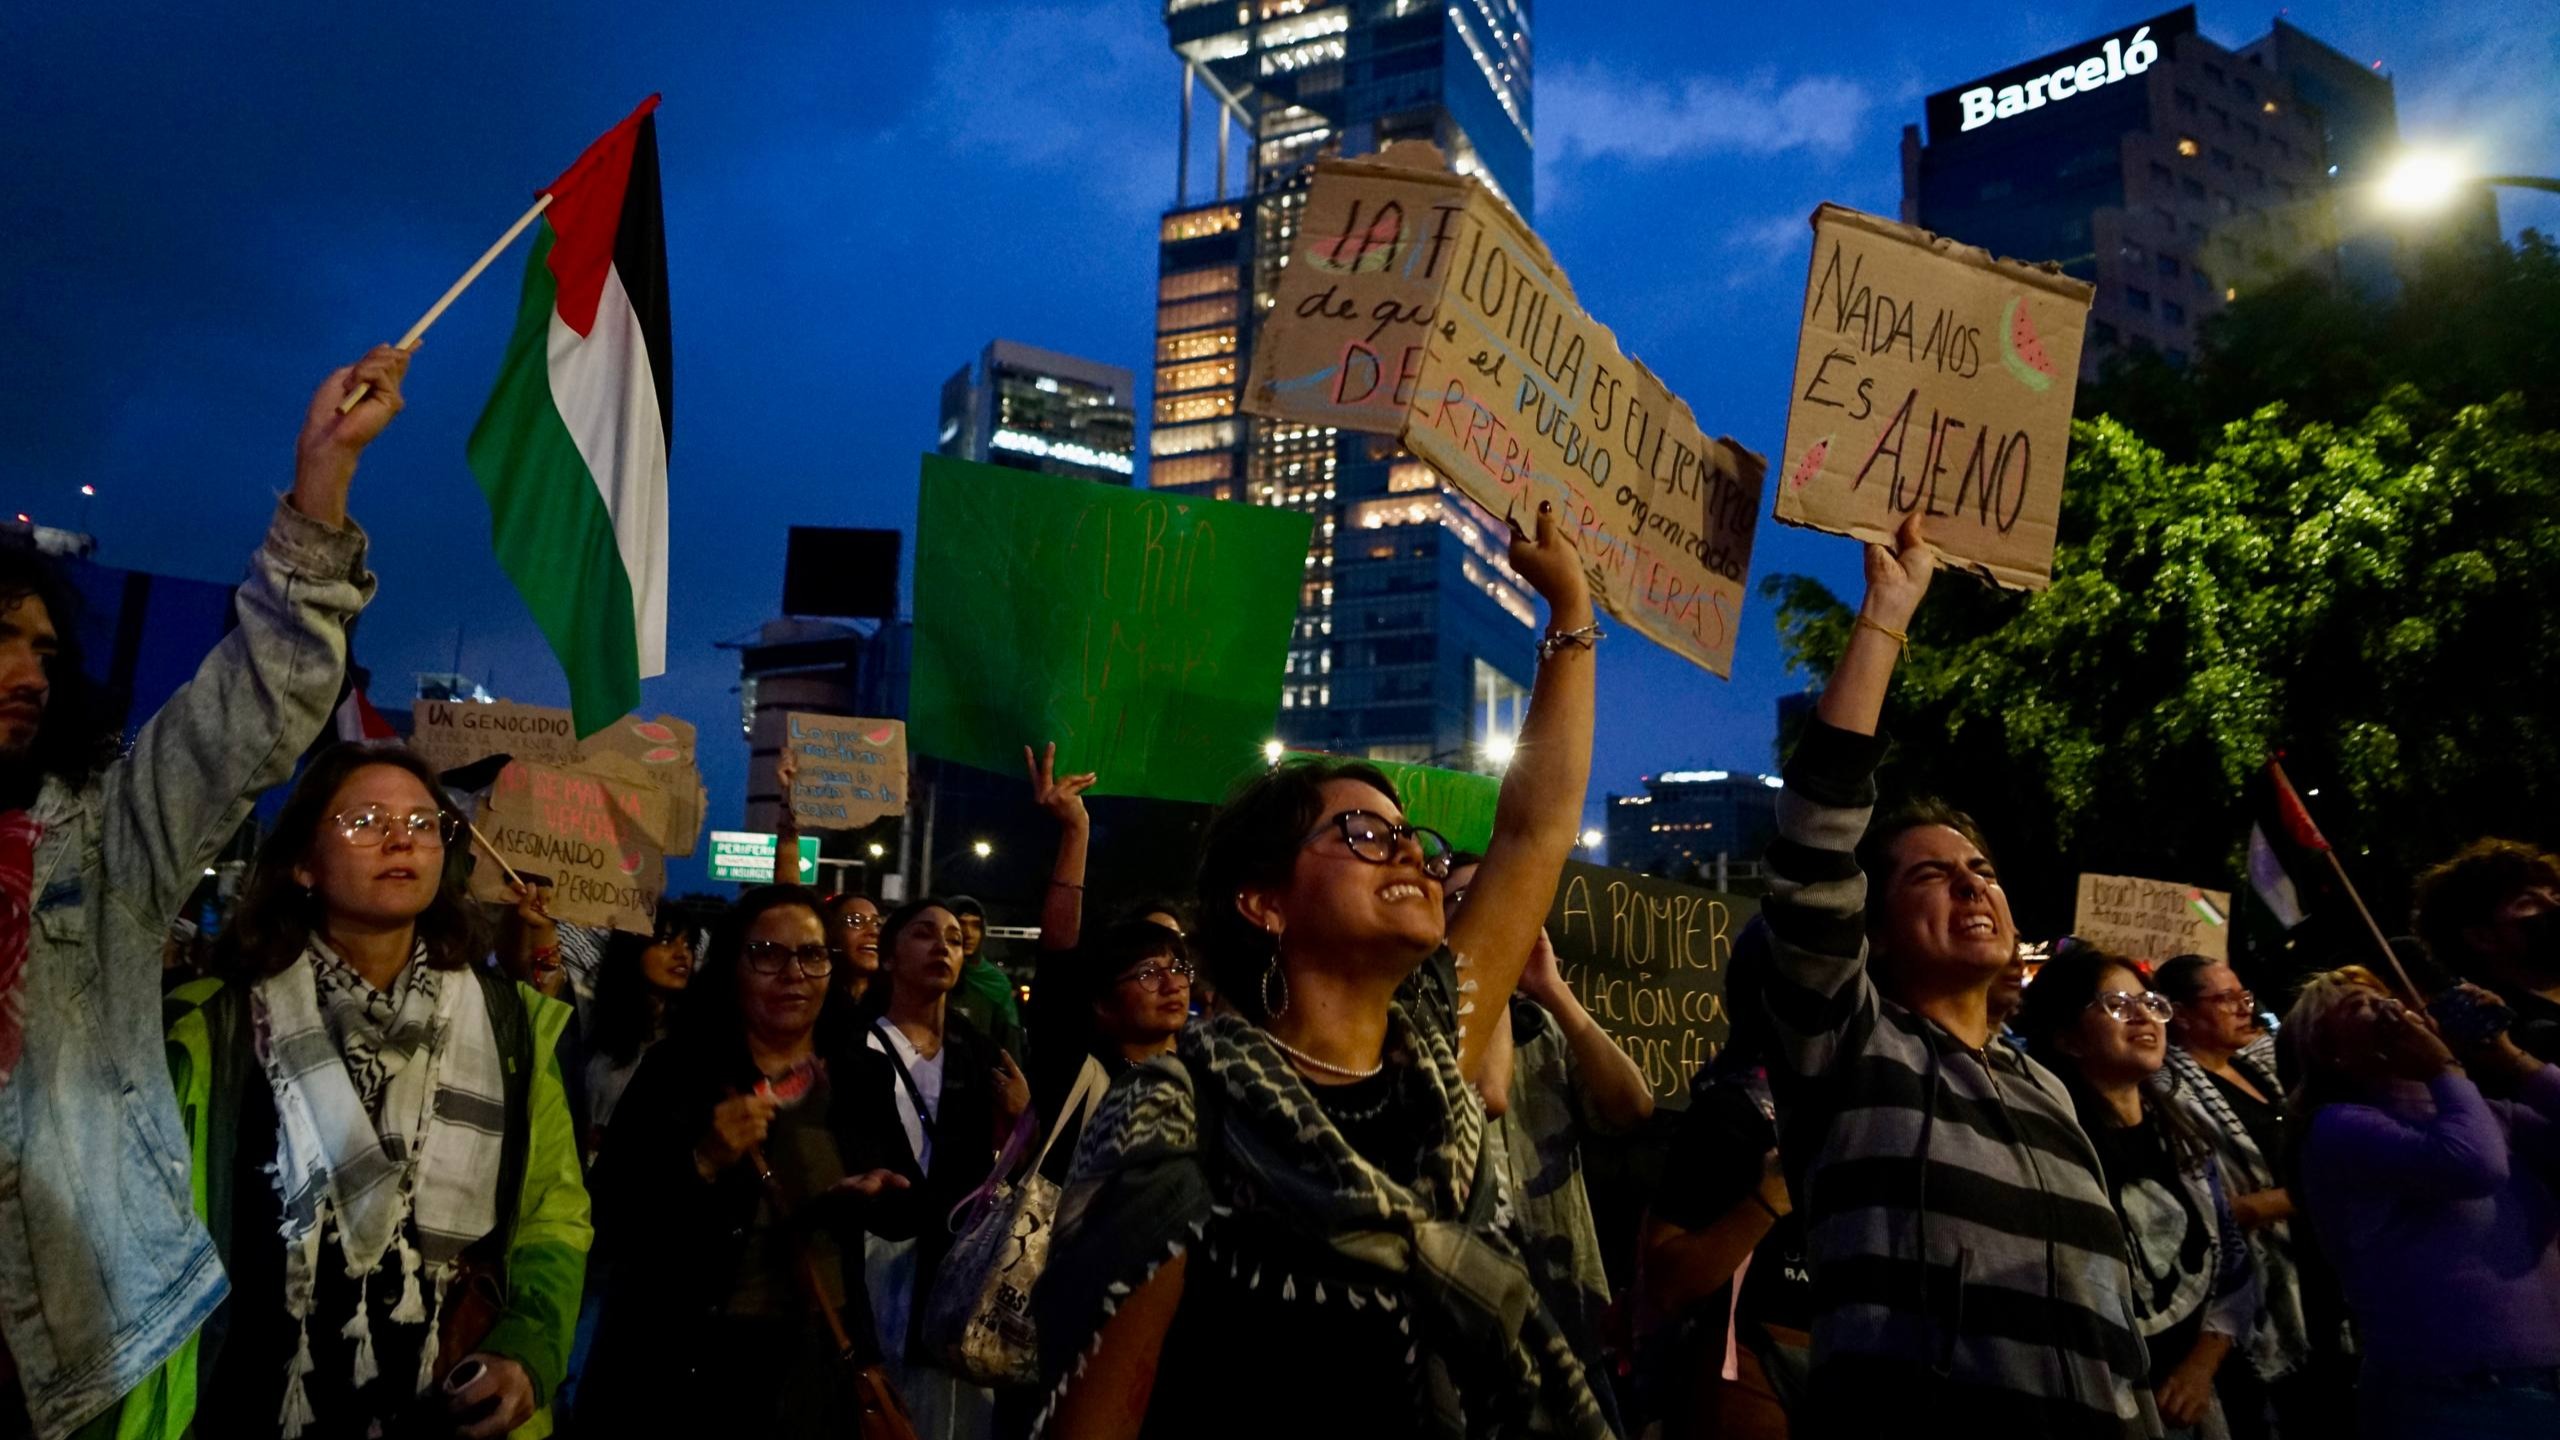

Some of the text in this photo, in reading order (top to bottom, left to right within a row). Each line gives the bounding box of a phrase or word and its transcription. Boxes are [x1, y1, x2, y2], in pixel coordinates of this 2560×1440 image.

[1959, 26, 2158, 132] Barceló
[1423, 205, 1585, 399] FLOTILLA
[1590, 364, 1622, 432] ES
[1624, 396, 1644, 470] EL
[1812, 239, 1980, 378] NADA NOS
[1297, 284, 1740, 580] de que el PUEBLO organizado
[1803, 347, 1875, 421] ES
[1852, 388, 2032, 533] AJENO
[429, 704, 570, 737] UN GENOCIDIO
[791, 718, 823, 739] Lo
[491, 826, 605, 870] ASESINANDO
[555, 869, 657, 916] PERIODISTAS
[1563, 875, 1732, 972] A ROMPER
